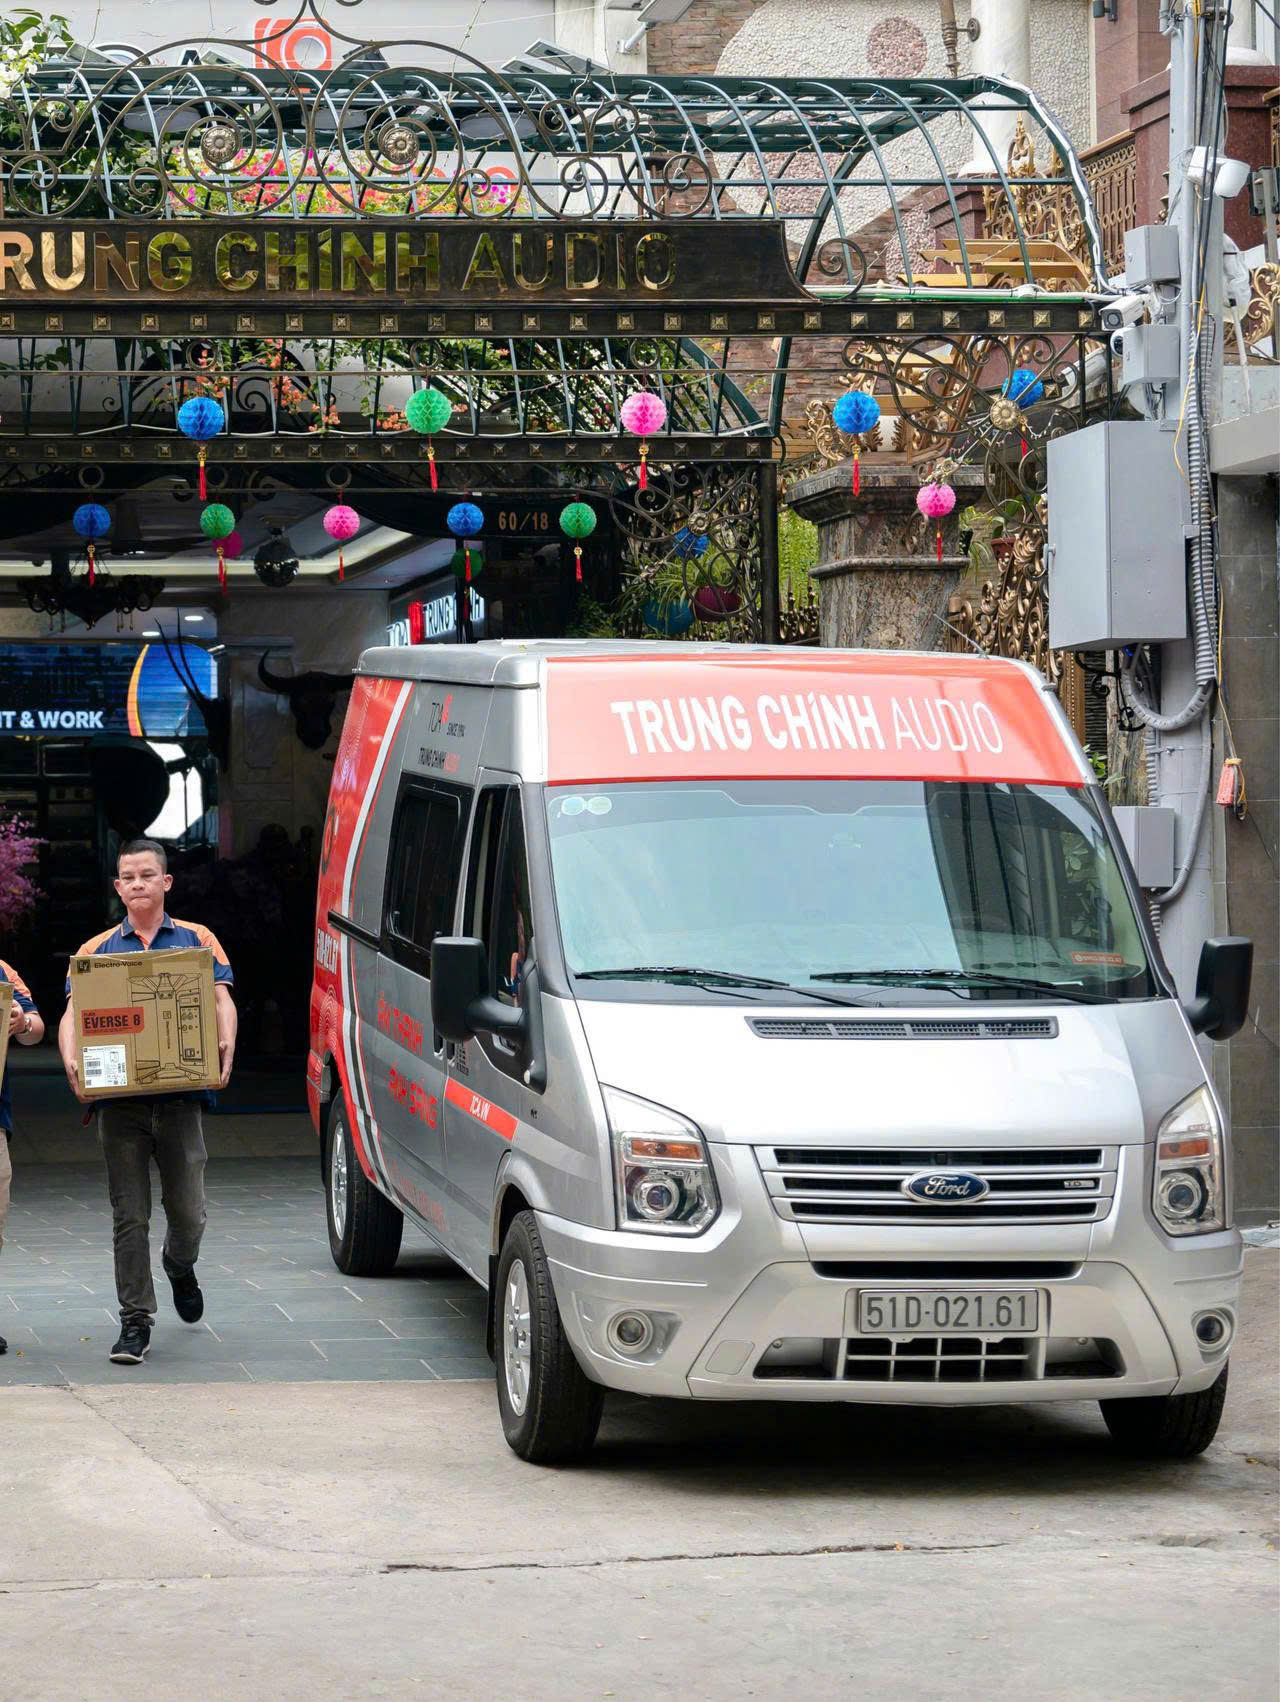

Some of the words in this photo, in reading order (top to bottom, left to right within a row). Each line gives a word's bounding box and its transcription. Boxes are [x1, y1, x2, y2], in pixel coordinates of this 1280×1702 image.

[216, 228, 441, 292] CHÍNH
[461, 231, 677, 292] AUDIO
[498, 512, 548, 530] 60/18
[20, 710, 35, 729] &
[38, 710, 104, 729] WORK
[610, 695, 753, 755] TRUNG
[756, 690, 887, 752] CHÍNH
[891, 696, 1005, 755] AUDIO
[84, 1015, 128, 1029] EVERSE
[133, 1014, 140, 1026] 8
[925, 1175, 970, 1196] Ford
[867, 1295, 1026, 1329] 51D-021.61
